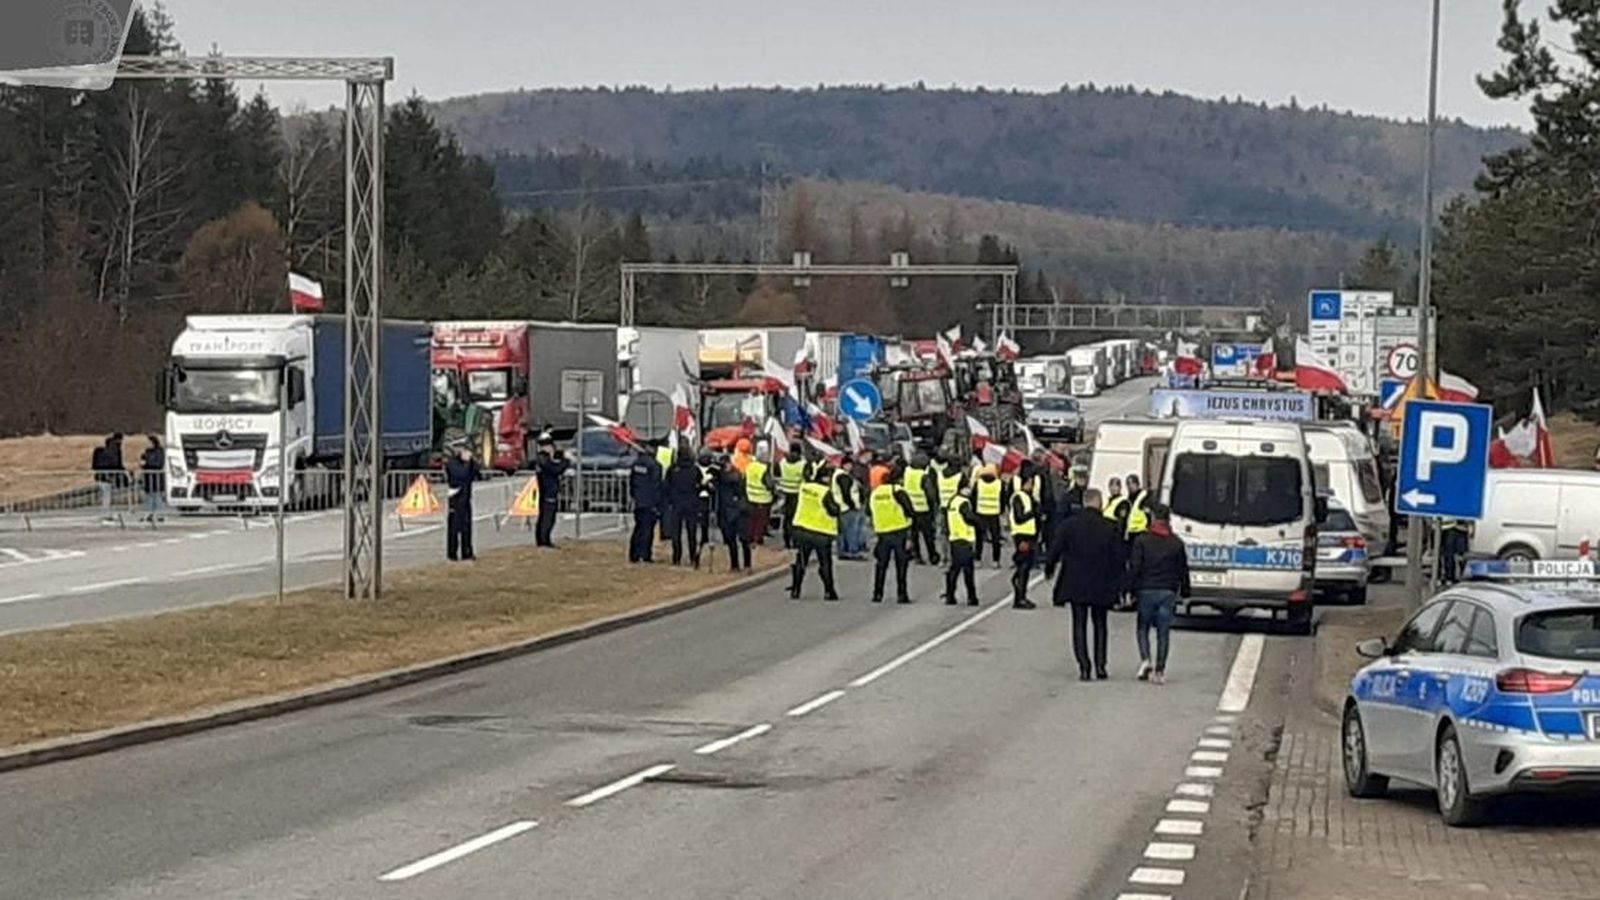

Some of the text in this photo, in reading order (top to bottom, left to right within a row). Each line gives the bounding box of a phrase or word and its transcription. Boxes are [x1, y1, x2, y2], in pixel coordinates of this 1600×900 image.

[190, 340, 265, 352] TRANSPORT
[1395, 353, 1418, 371] 70
[1242, 396, 1305, 412] CHRYSTUS
[1415, 410, 1469, 482] P
[1277, 550, 1302, 564] 710
[1536, 562, 1590, 575] POLICJA
